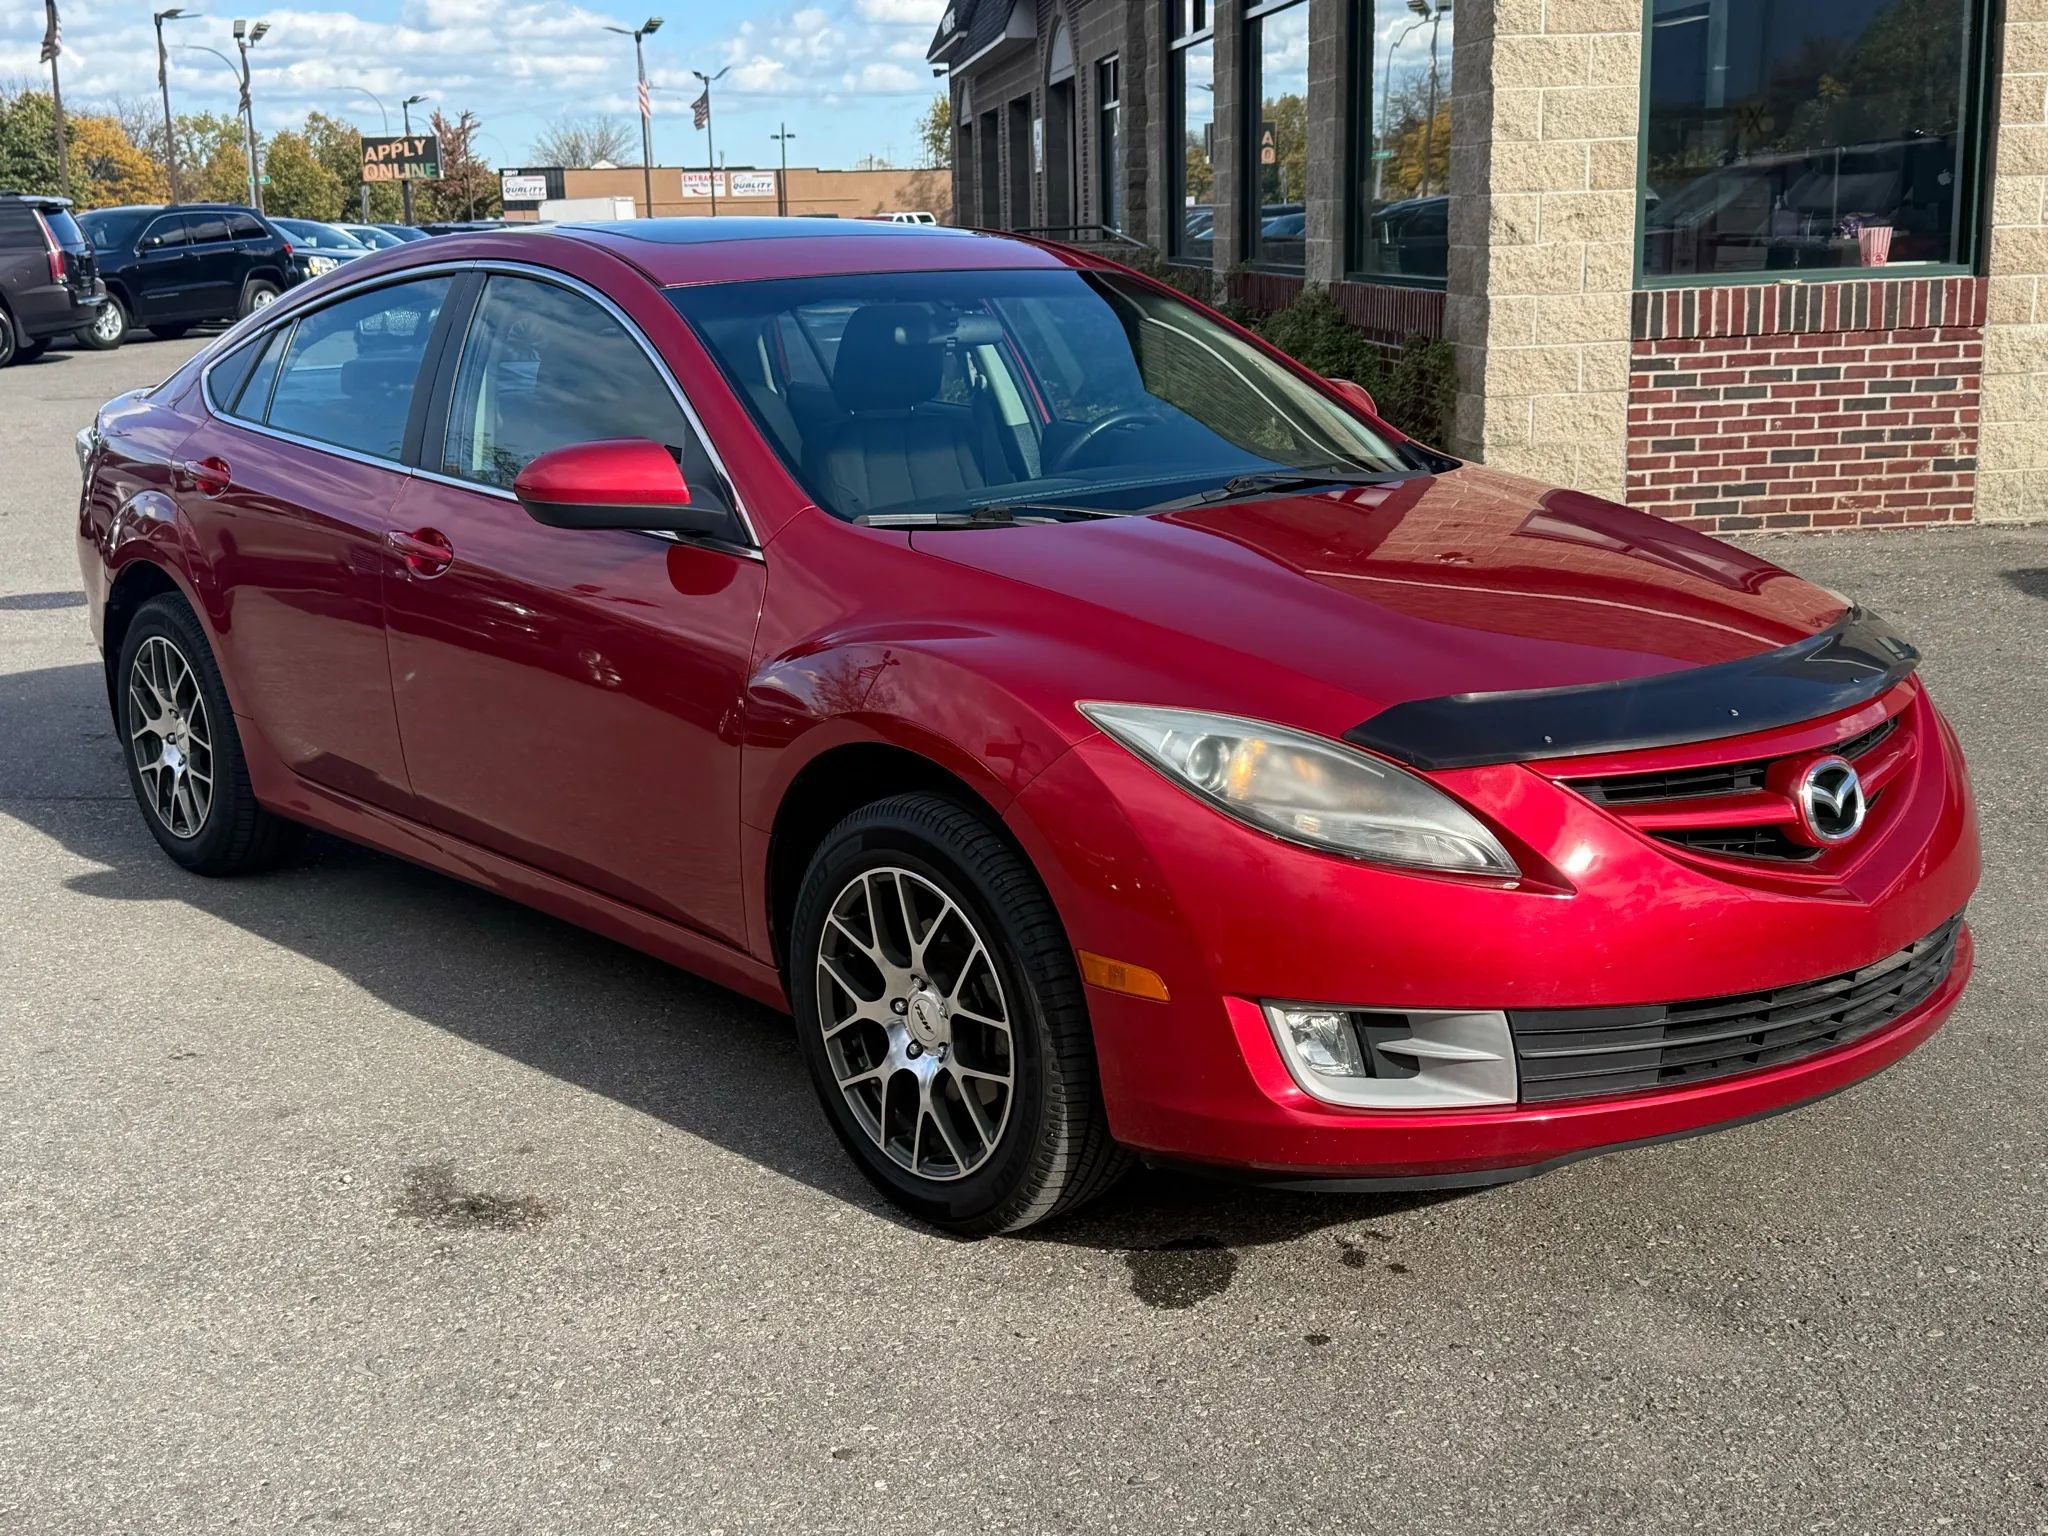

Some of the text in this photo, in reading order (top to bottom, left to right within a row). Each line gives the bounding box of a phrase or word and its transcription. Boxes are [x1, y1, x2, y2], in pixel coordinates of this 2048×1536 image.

[364, 139, 426, 163] APPLY
[363, 163, 437, 181] ONLINE
[733, 182, 772, 190] QUALITY
[914, 1003, 935, 1034] TSW
